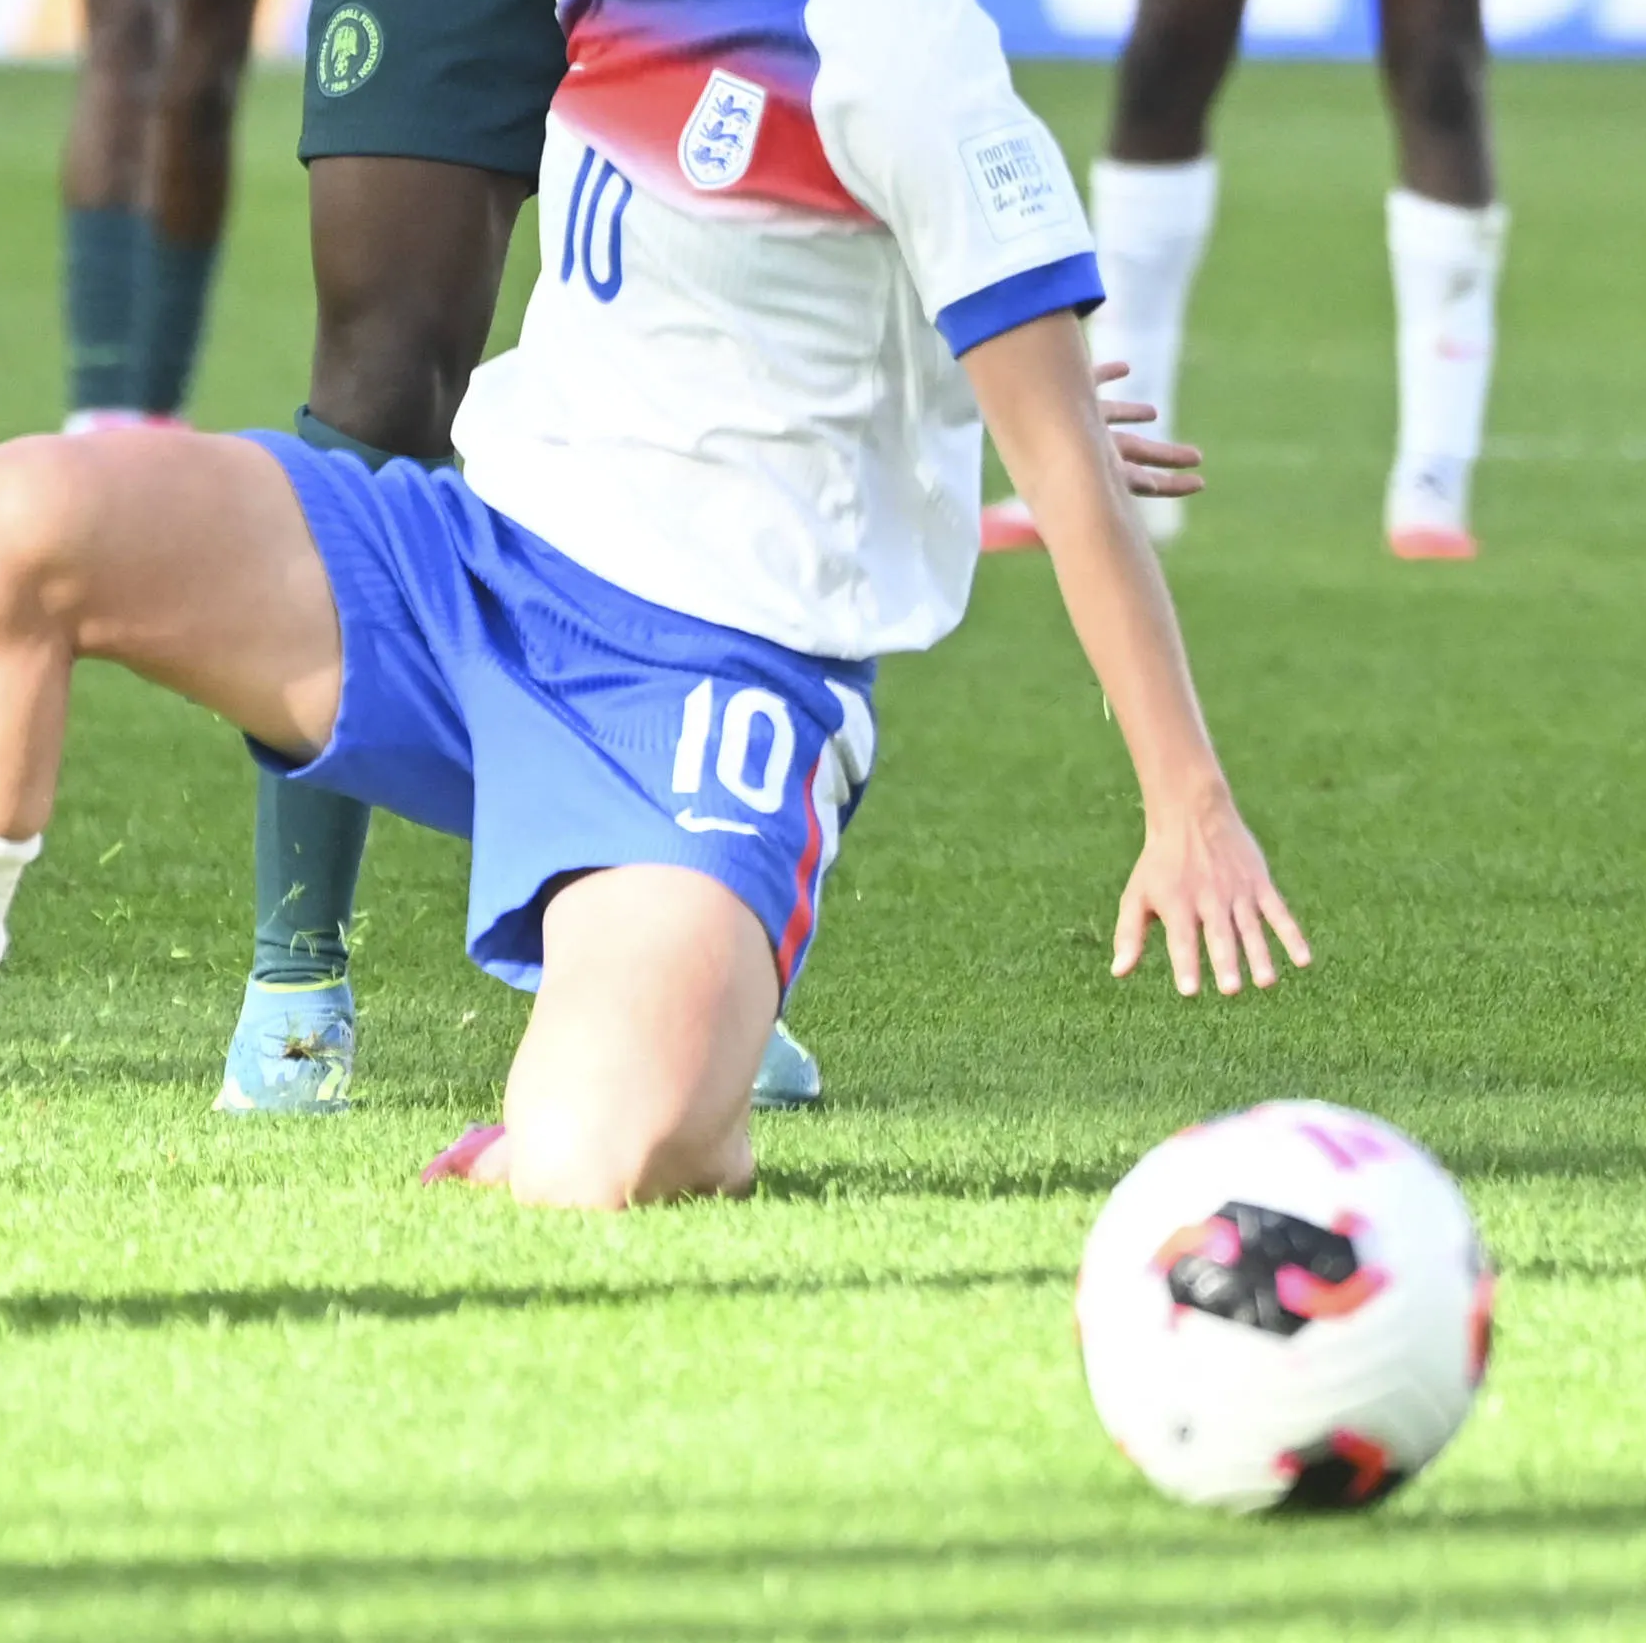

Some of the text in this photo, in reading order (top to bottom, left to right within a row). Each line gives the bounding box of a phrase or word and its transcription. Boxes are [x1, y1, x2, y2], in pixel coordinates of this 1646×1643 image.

[358, 13, 379, 79] FEDERATION
[976, 138, 1032, 167] FOOTBALL
[984, 157, 1042, 190] UNITES
[560, 145, 633, 304] 10
[672, 675, 797, 815] 10
